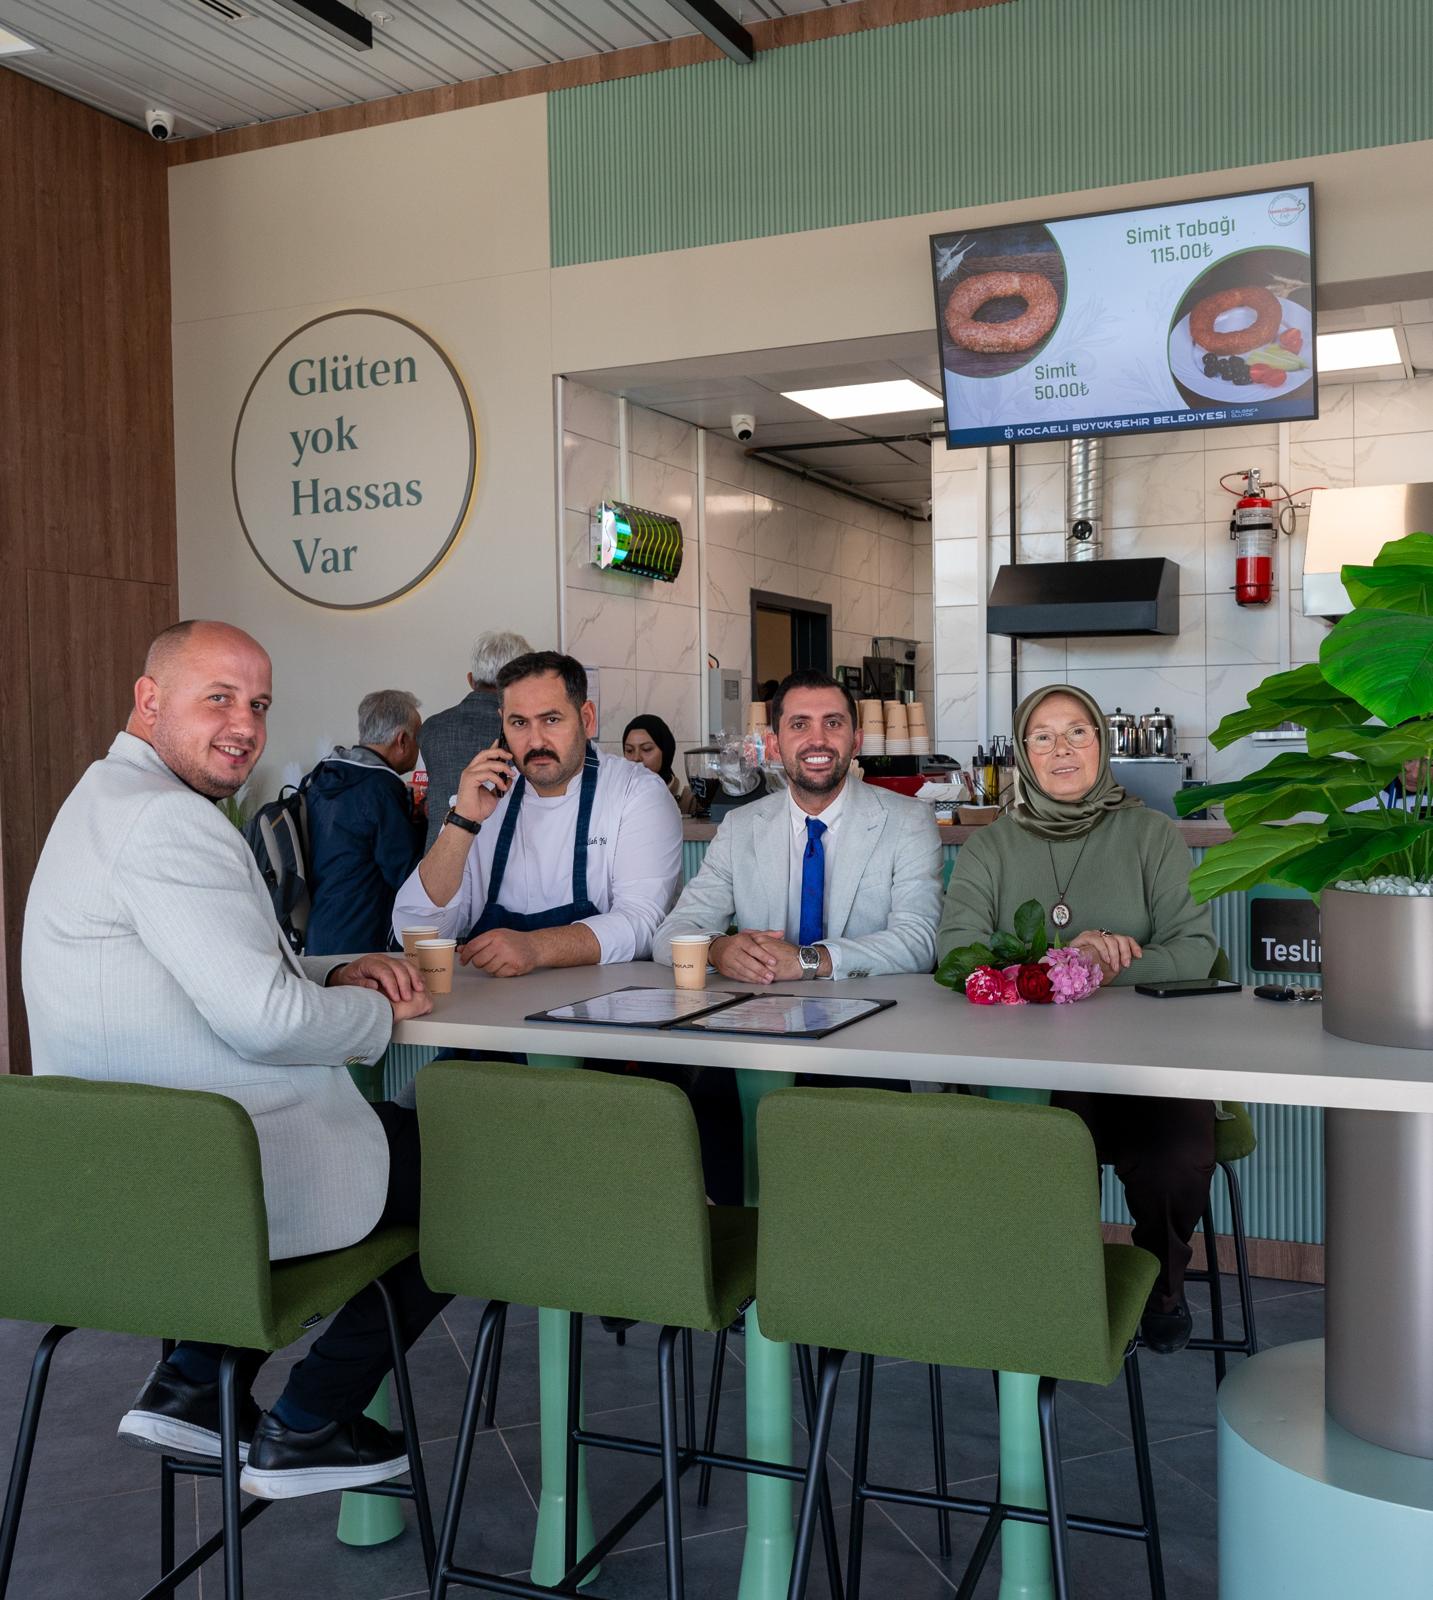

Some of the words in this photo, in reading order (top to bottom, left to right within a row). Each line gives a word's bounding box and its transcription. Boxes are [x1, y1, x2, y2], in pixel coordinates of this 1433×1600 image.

[1126, 223, 1172, 245] Simit
[1176, 215, 1236, 237] Tabağı
[288, 355, 418, 396] Glüten
[1034, 361, 1078, 381] Simit
[1153, 411, 1227, 425] BELEDİYESİ
[289, 415, 359, 468] yok
[291, 478, 423, 517] Hassas
[292, 537, 358, 574] Var
[1261, 937, 1322, 962] Tesli
